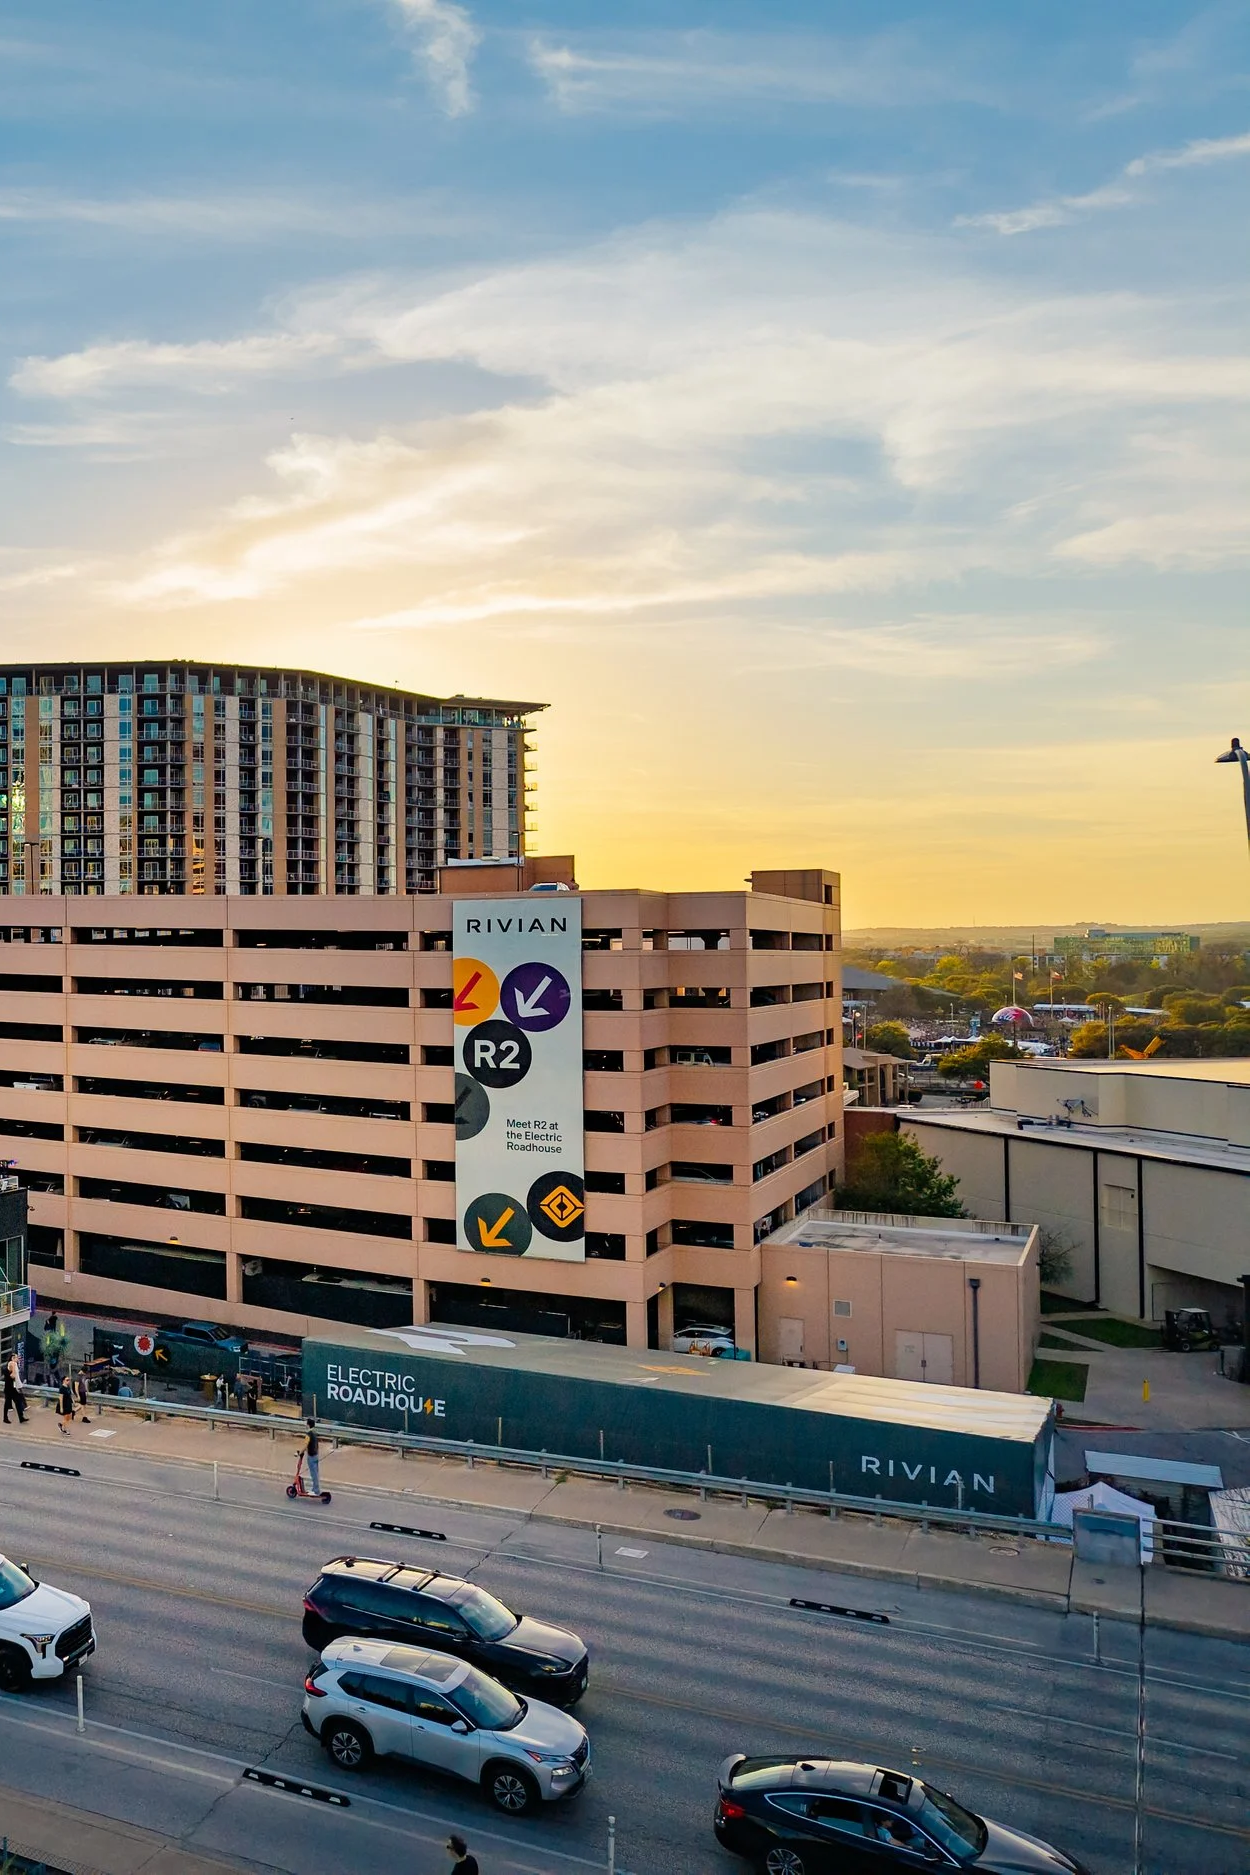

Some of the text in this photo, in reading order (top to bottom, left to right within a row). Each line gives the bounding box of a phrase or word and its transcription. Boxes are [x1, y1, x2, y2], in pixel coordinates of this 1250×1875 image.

[466, 917, 567, 933] RIVIAN
[474, 1039, 521, 1070] R2
[506, 1118, 559, 1131] Meet R2 at
[506, 1131, 563, 1142] the Electric
[506, 1142, 563, 1154] Roadhouse
[327, 1363, 416, 1393] ELECTRIC
[861, 1455, 996, 1494] RIVIAN
